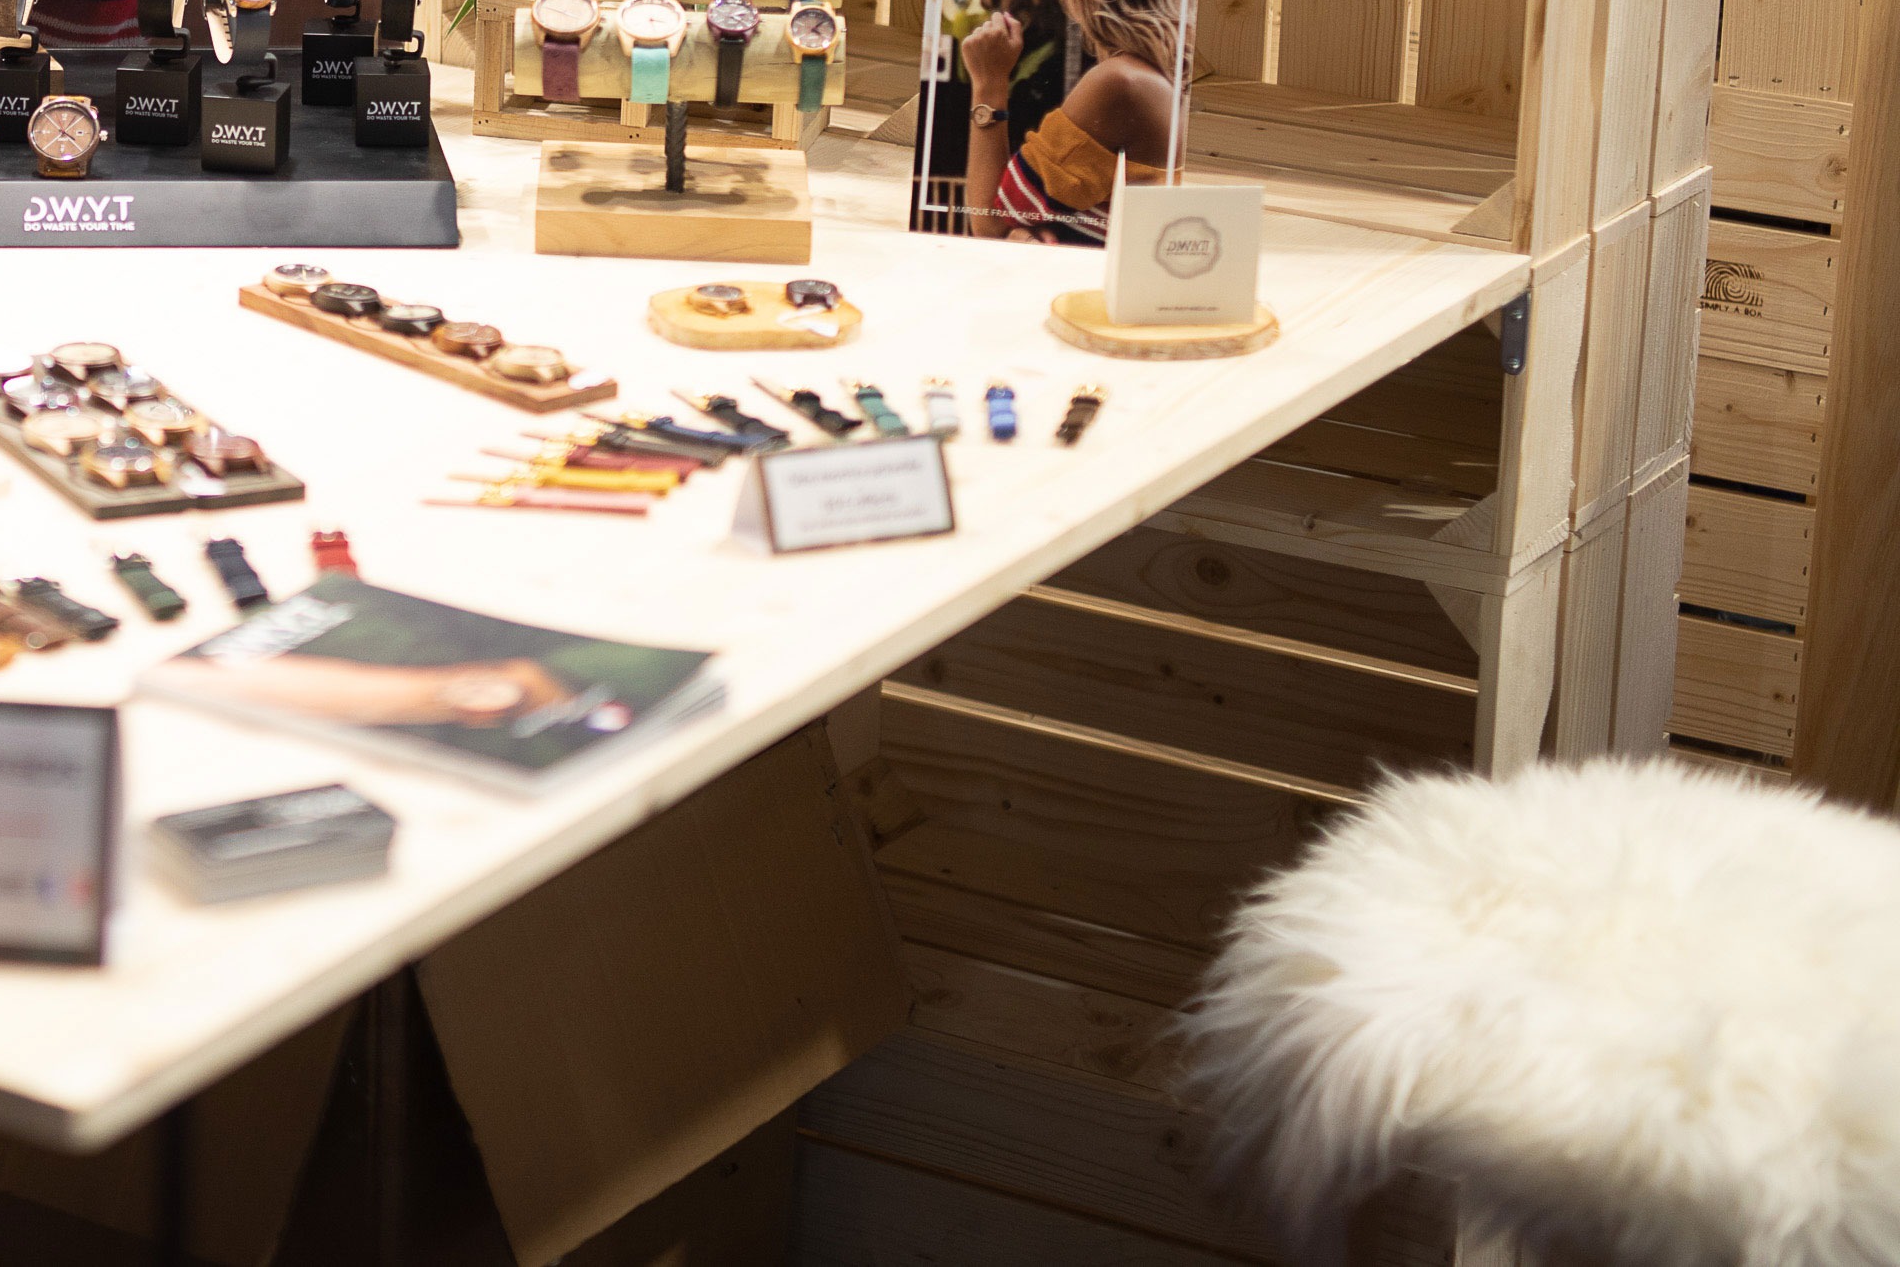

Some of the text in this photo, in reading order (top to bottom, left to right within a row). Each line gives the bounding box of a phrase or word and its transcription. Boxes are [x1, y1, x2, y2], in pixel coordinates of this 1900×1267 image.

[312, 60, 354, 74] D.W.Y
[126, 96, 179, 113] D.W.Y.T
[367, 101, 421, 116] D.W.Y.T
[211, 124, 266, 141] D.W.Y.T
[24, 195, 135, 222] D.W.Y.T
[23, 222, 135, 232] DO WASTE YOUR TIME
[1734, 306, 1740, 314] A
